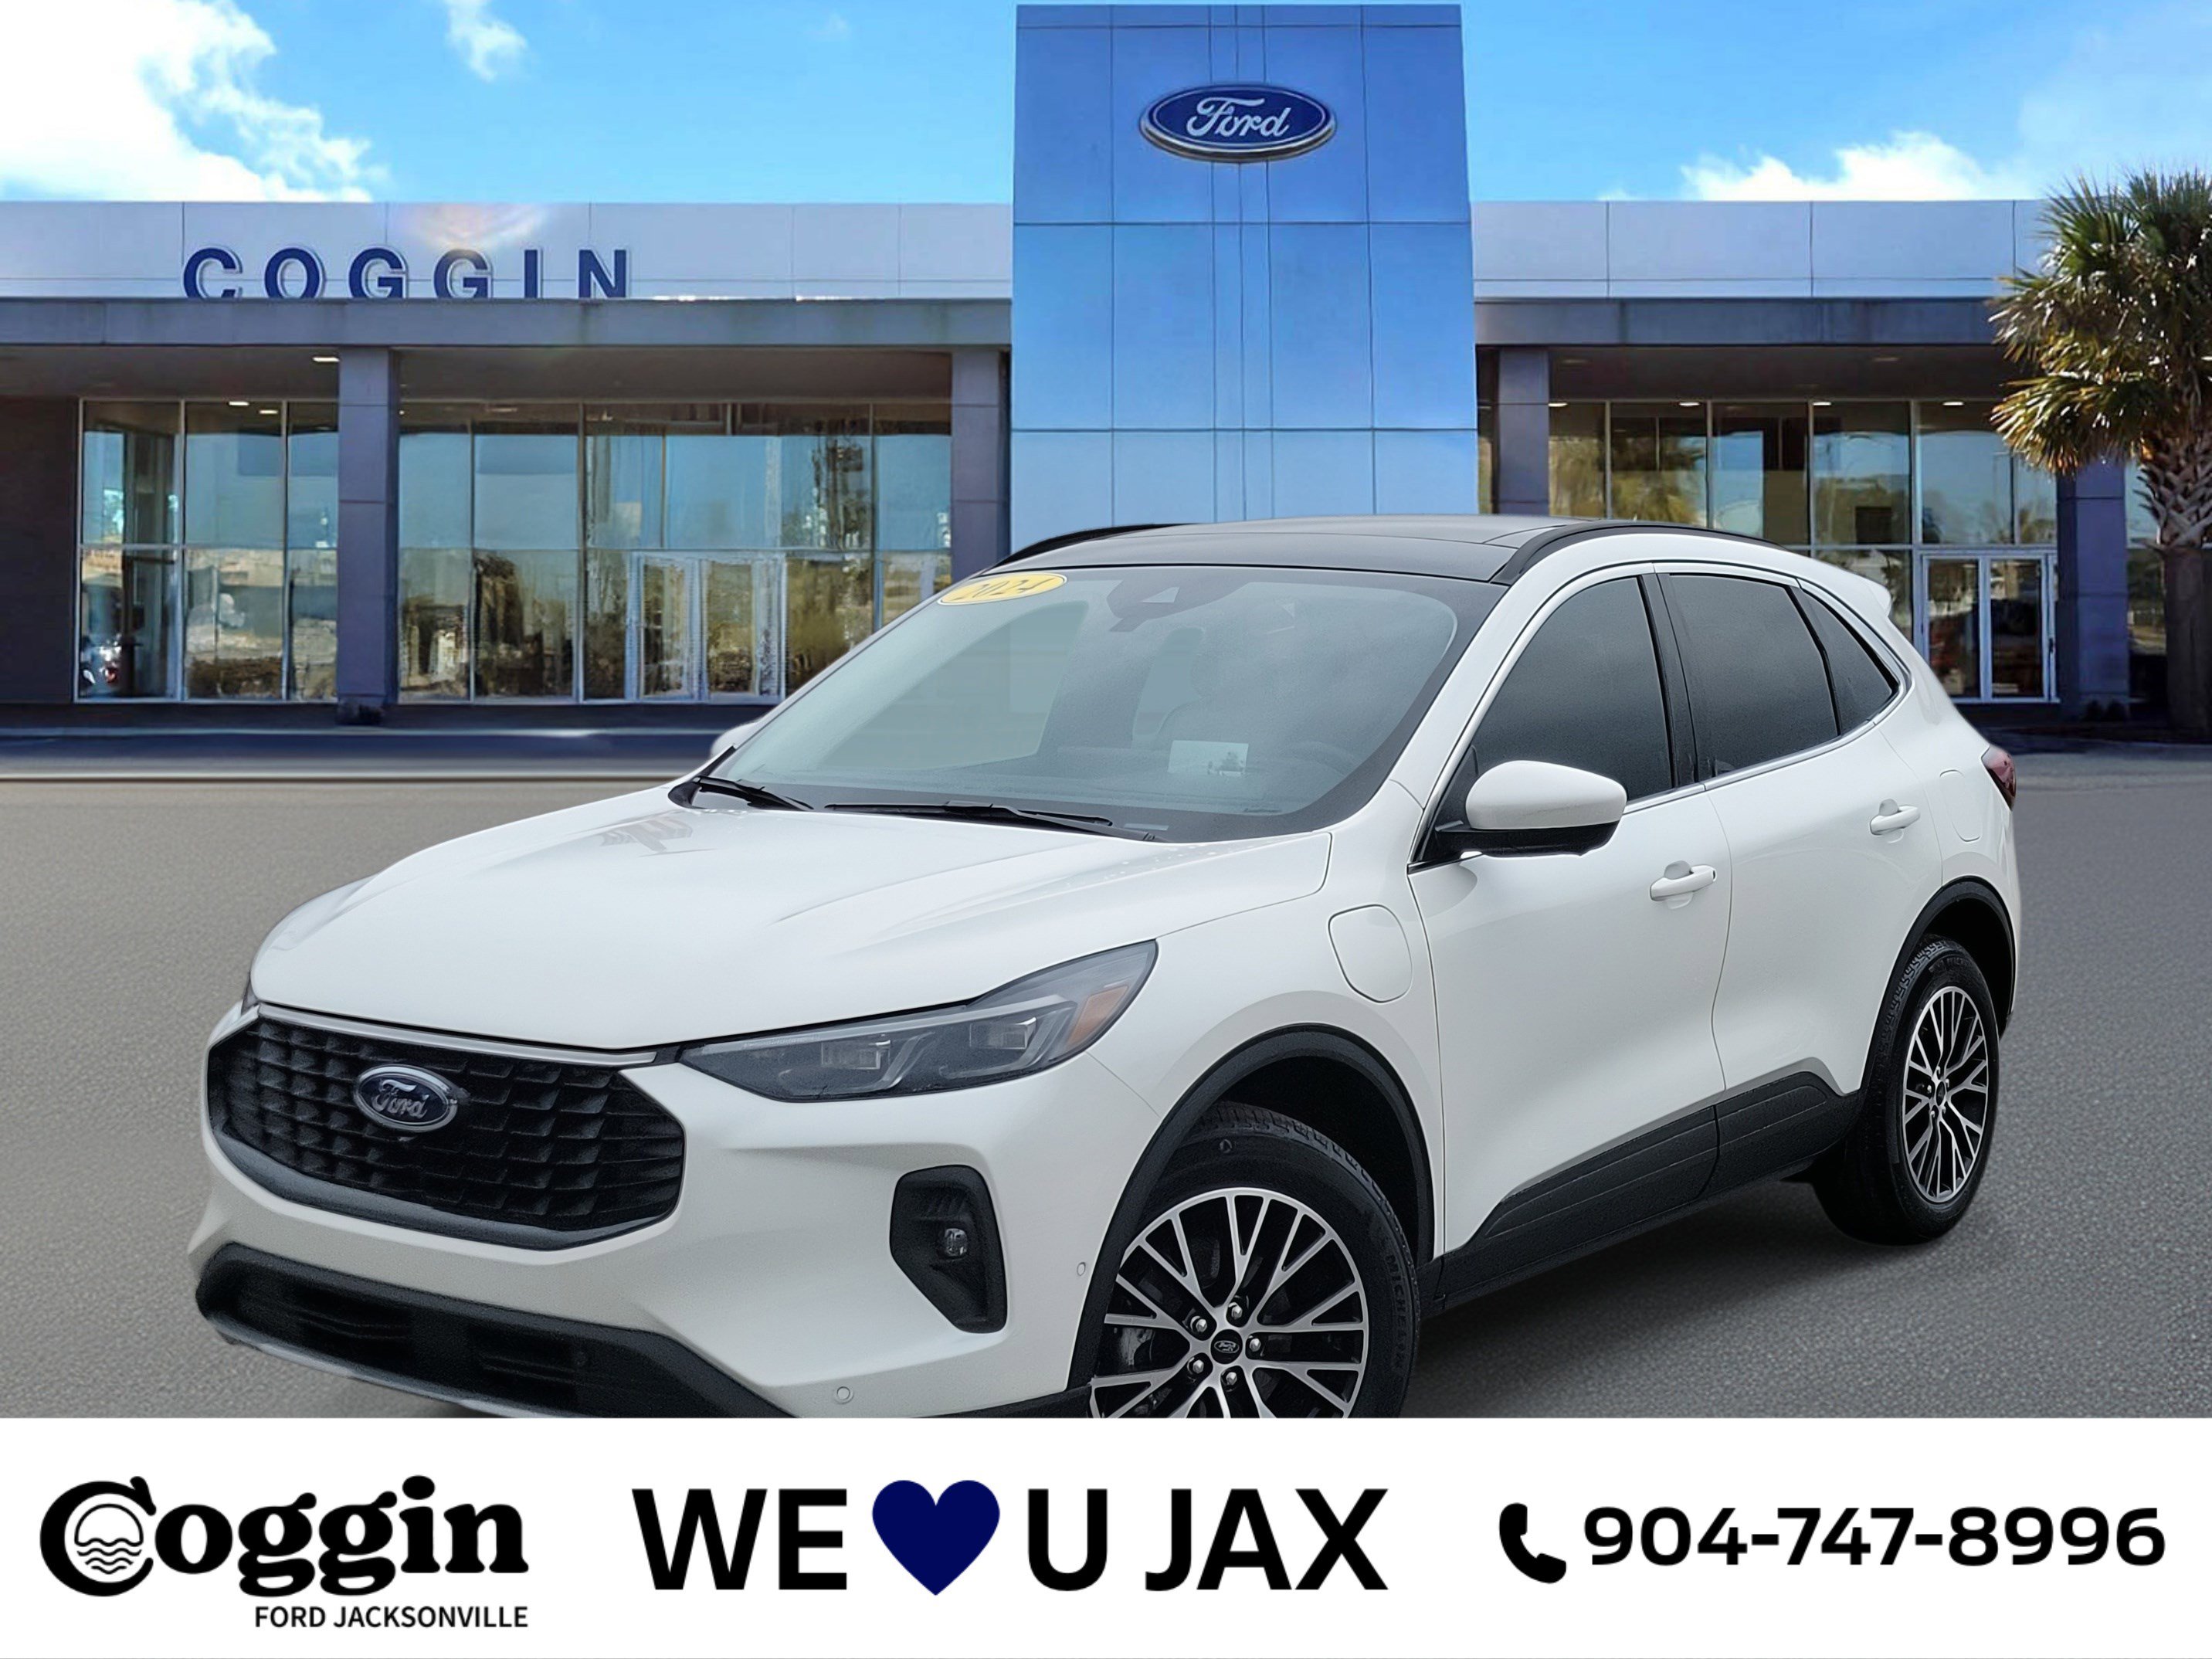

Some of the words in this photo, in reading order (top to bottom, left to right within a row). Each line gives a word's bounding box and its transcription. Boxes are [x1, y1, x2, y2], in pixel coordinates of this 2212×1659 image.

[1186, 97, 1291, 137] Ford
[183, 248, 627, 299] COGGIN
[371, 1079, 429, 1118] Ford
